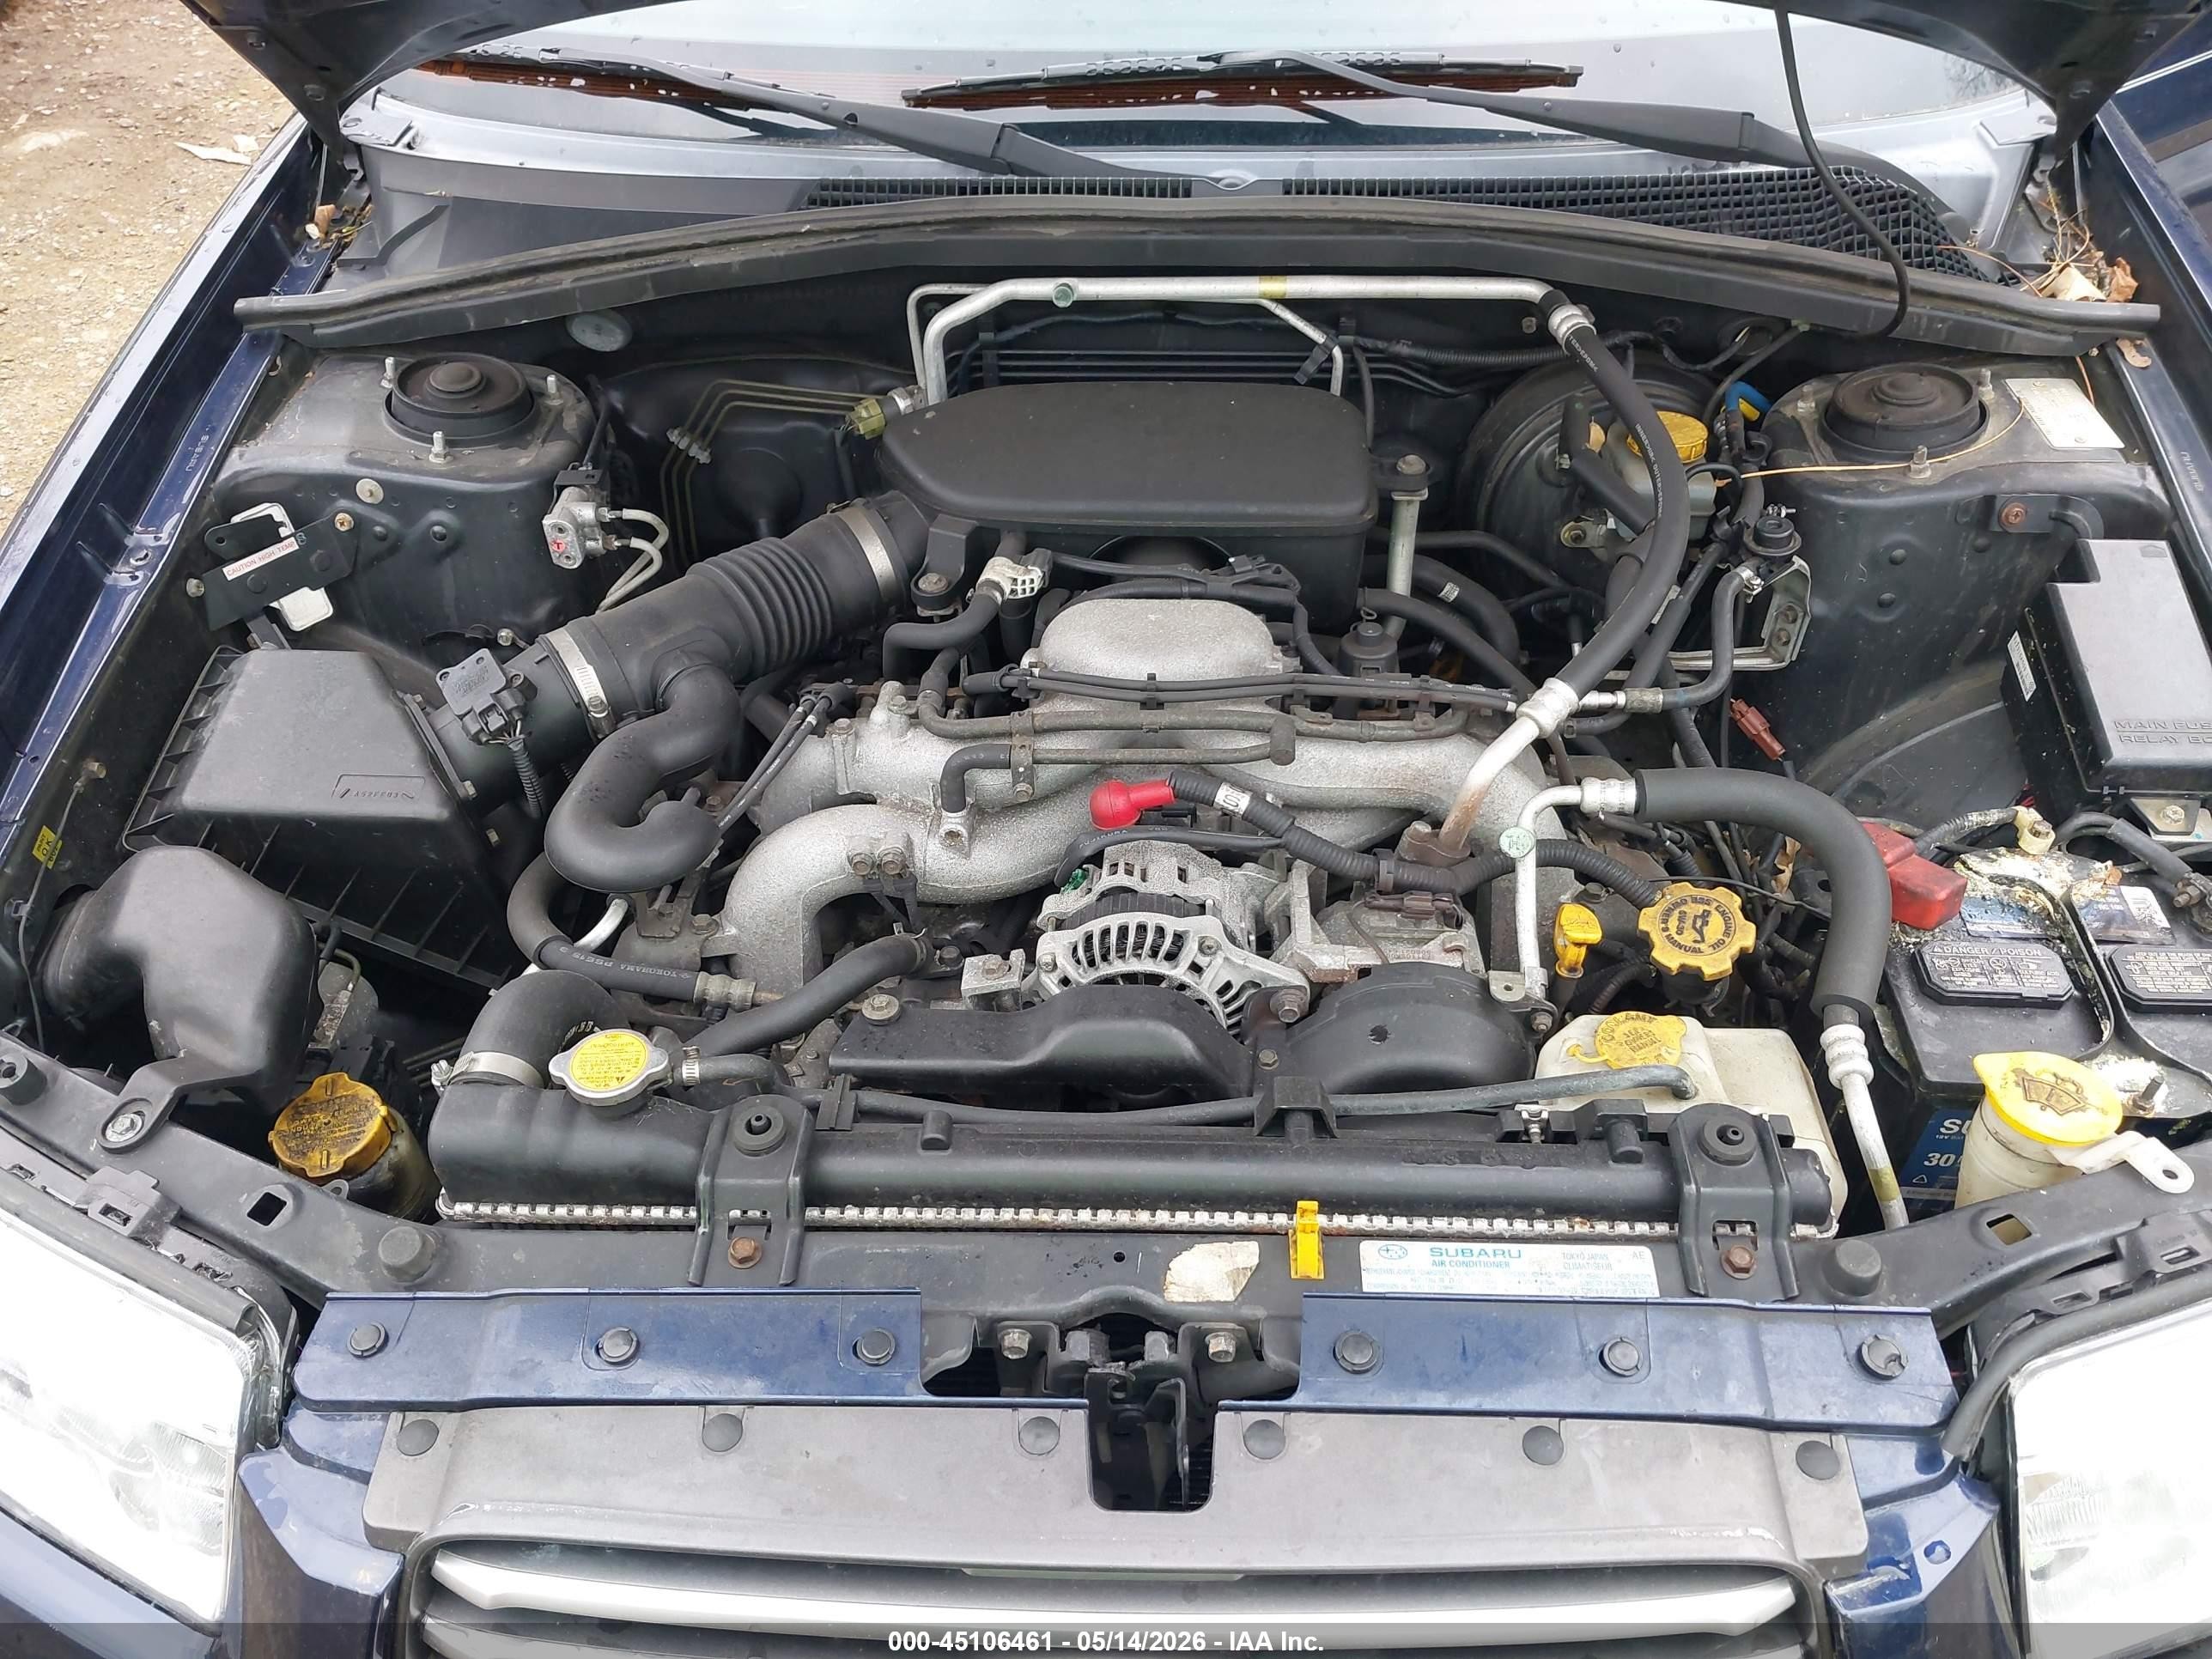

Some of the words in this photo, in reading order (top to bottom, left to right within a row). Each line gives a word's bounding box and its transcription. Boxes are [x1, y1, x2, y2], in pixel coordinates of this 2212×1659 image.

[185, 434, 210, 471] SUBARU
[554, 542, 563, 550] T
[226, 558, 257, 577] CAUTION
[258, 550, 276, 562] HIGH
[276, 541, 295, 554] TEMP
[2113, 720, 2168, 730] MAIN
[2118, 735, 2179, 744] RELAY
[1691, 895, 1712, 907] SEE
[1715, 904, 1734, 939] ENGINE
[1665, 933, 1704, 955] MANUAL
[1709, 937, 1726, 951] OIL
[1943, 946, 1990, 955] DANGER
[2000, 948, 2043, 957] POISON
[619, 963, 678, 978] YOKOHAMA
[1429, 1247, 1522, 1259] SUBARU
[1632, 1250, 1645, 1260] AE
[1431, 1259, 1446, 1268] AIR
[1448, 1260, 1510, 1269] CONDITIONER
